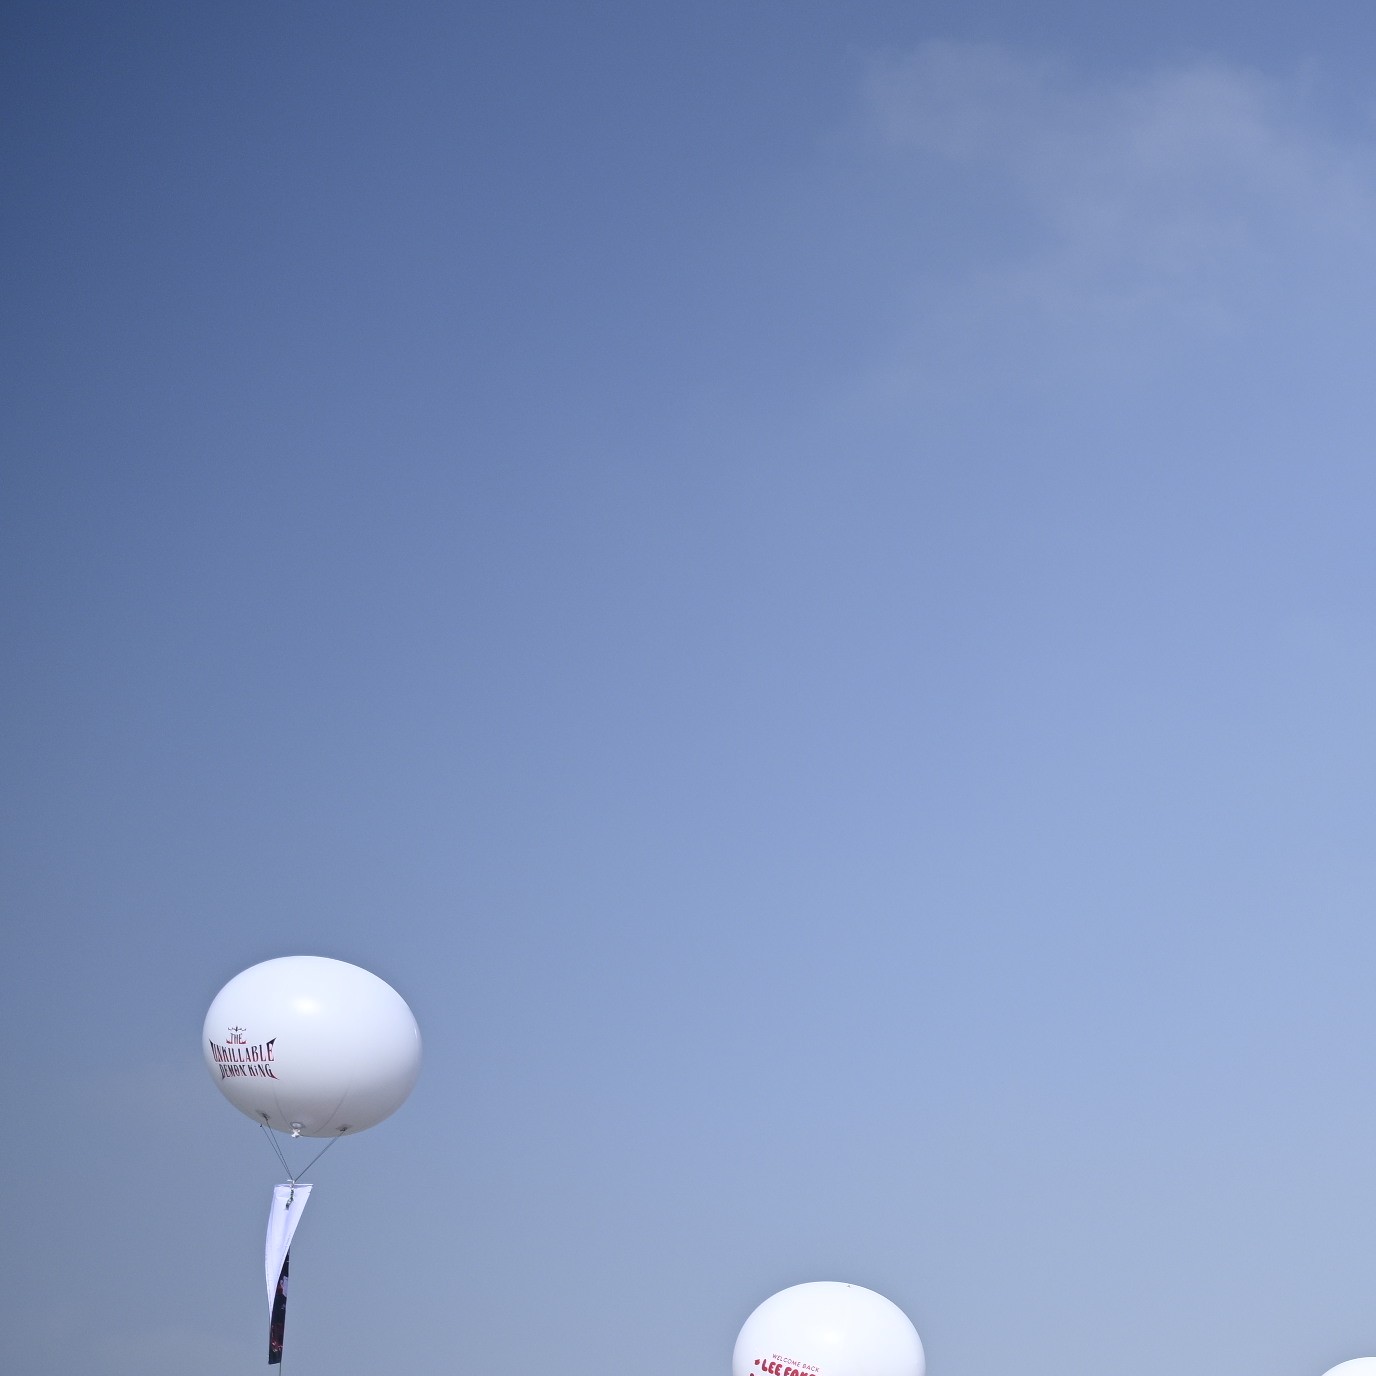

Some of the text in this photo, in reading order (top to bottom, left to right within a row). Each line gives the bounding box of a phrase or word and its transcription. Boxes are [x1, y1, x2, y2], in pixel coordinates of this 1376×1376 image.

[209, 1037, 277, 1062] UNKILLABLE
[761, 1359, 783, 1376] LEE
[772, 1353, 801, 1368] WELCOME
